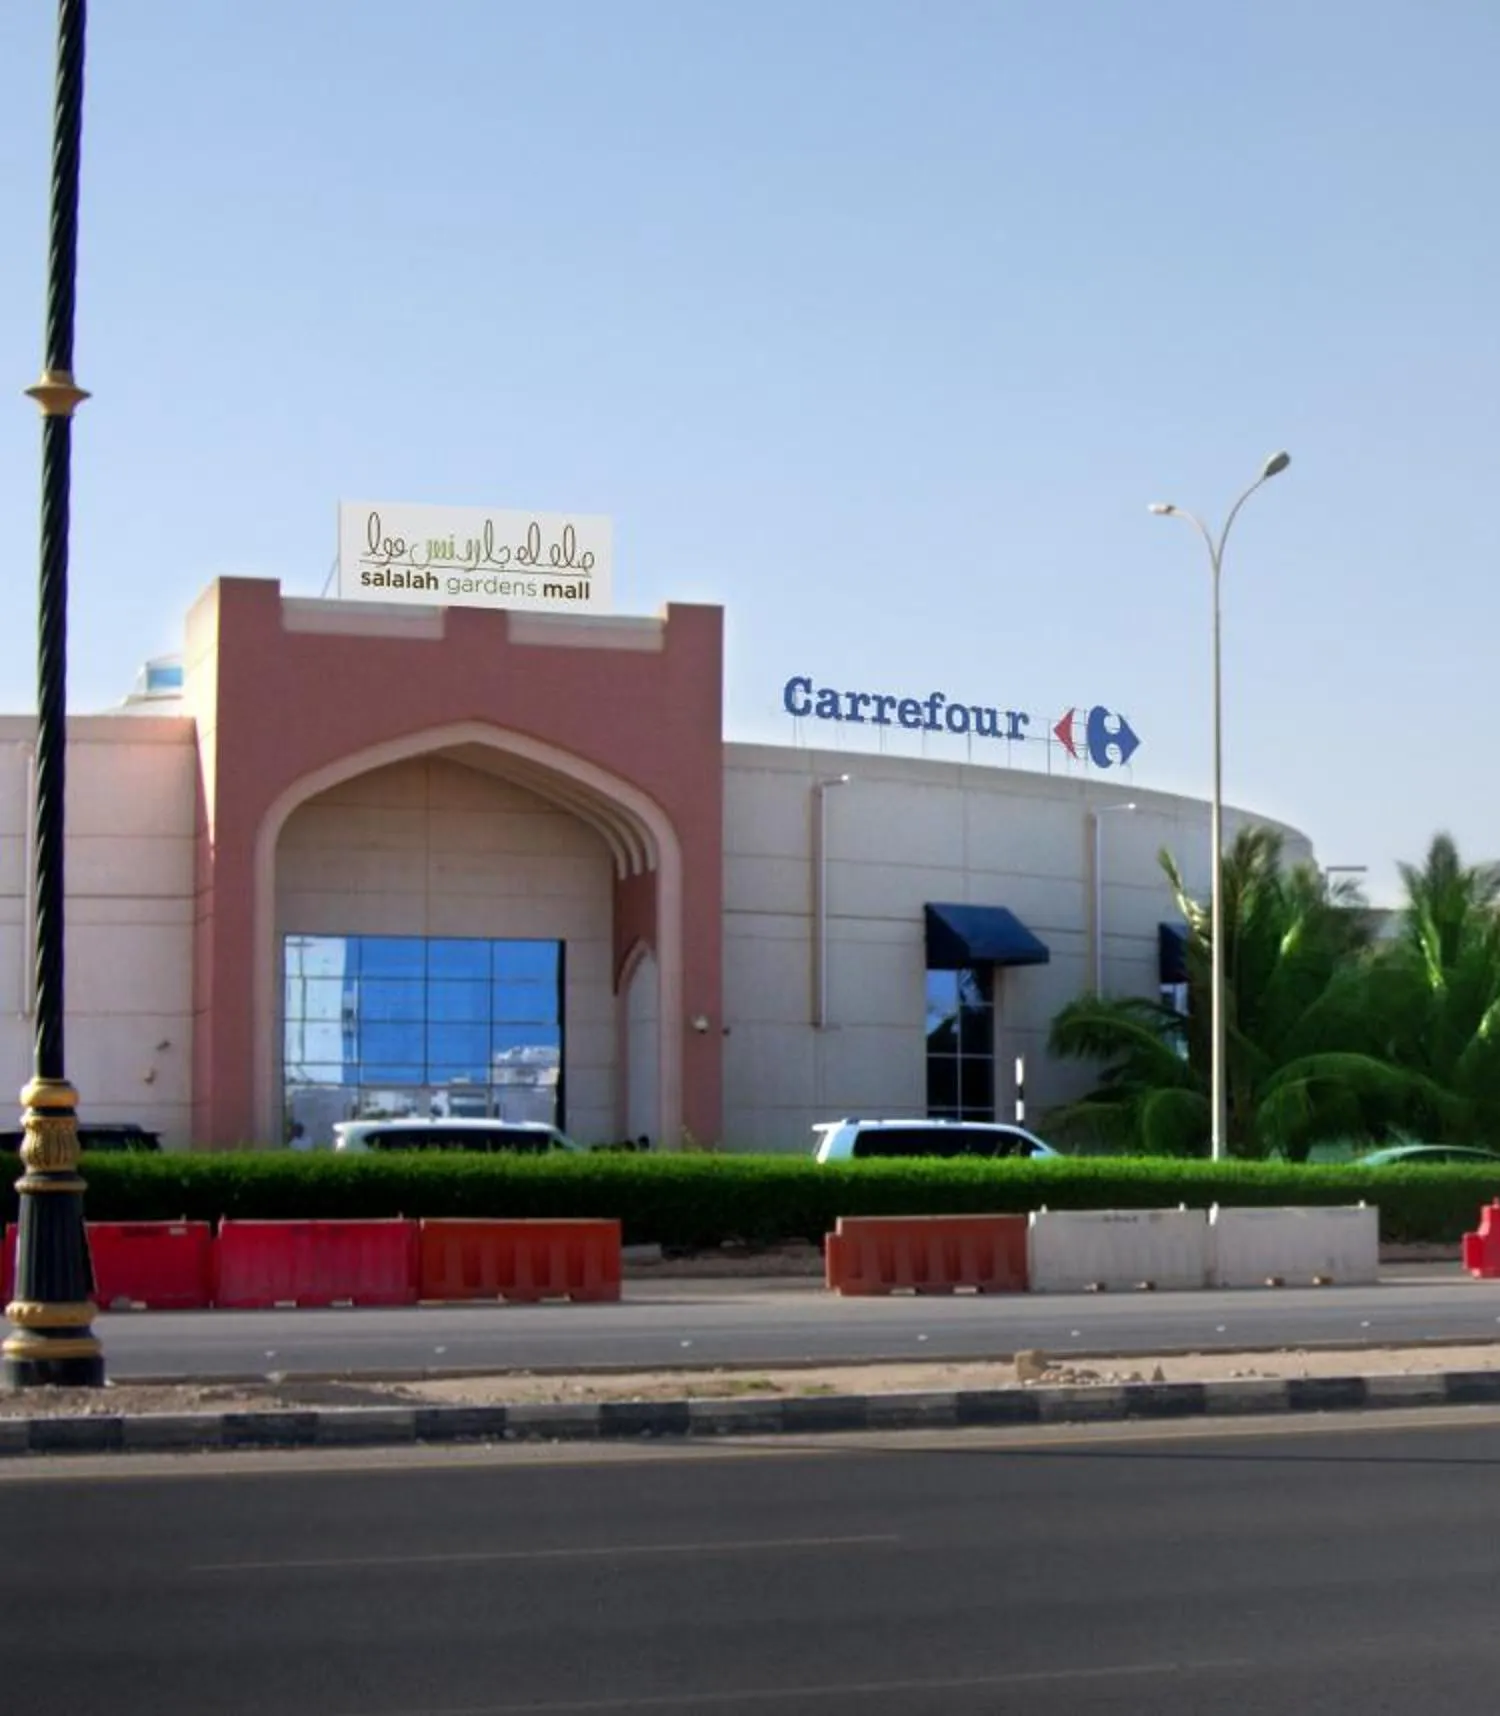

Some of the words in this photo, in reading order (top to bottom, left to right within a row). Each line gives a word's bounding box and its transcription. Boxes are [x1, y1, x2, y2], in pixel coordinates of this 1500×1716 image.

[360, 568, 439, 591] salalah
[446, 574, 537, 597] gardens
[542, 581, 590, 600] mall
[783, 673, 1030, 740] Carrefour
